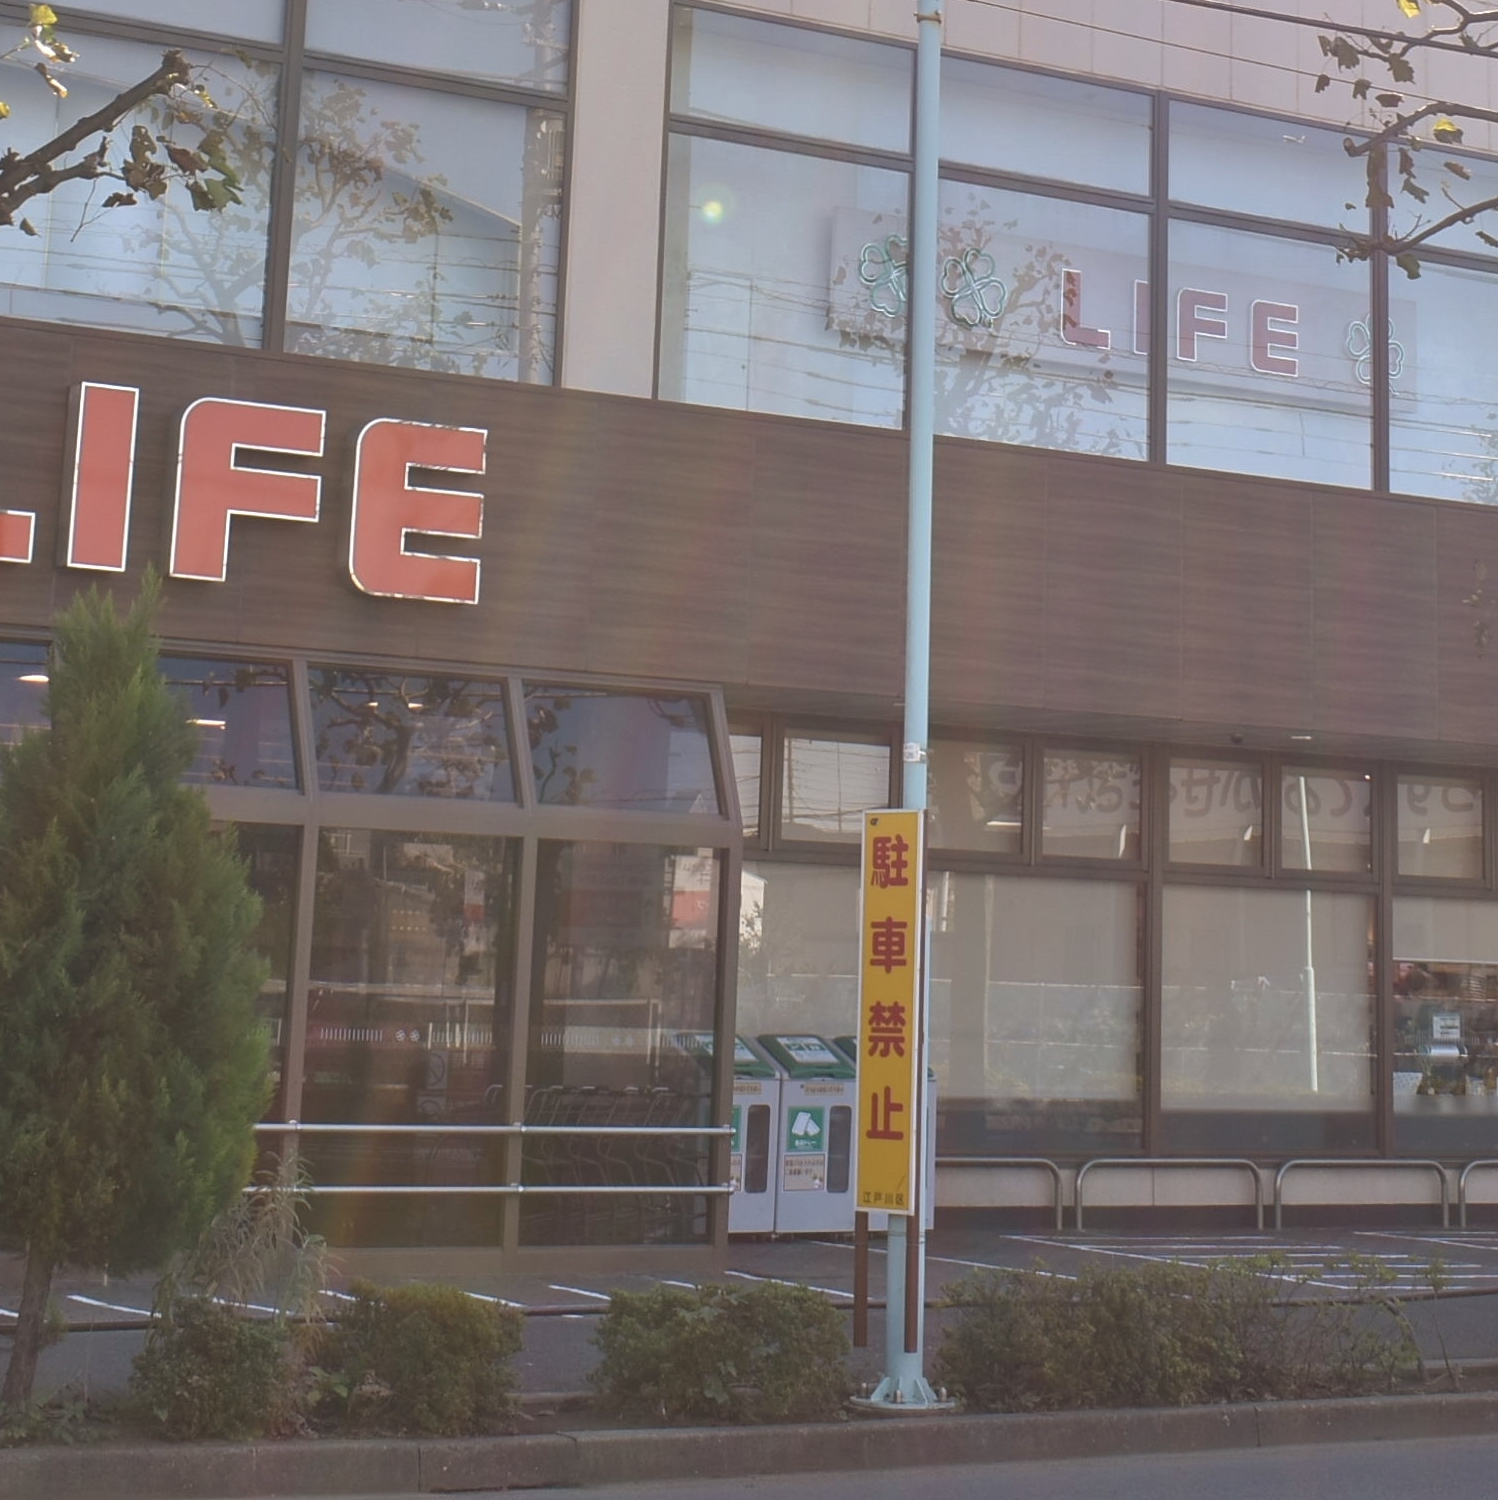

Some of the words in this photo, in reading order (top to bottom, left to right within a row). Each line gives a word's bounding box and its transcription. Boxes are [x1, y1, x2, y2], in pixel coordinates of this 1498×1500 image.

[1060, 267, 1299, 377] LIFE
[866, 833, 909, 1141] 駐車禁止
